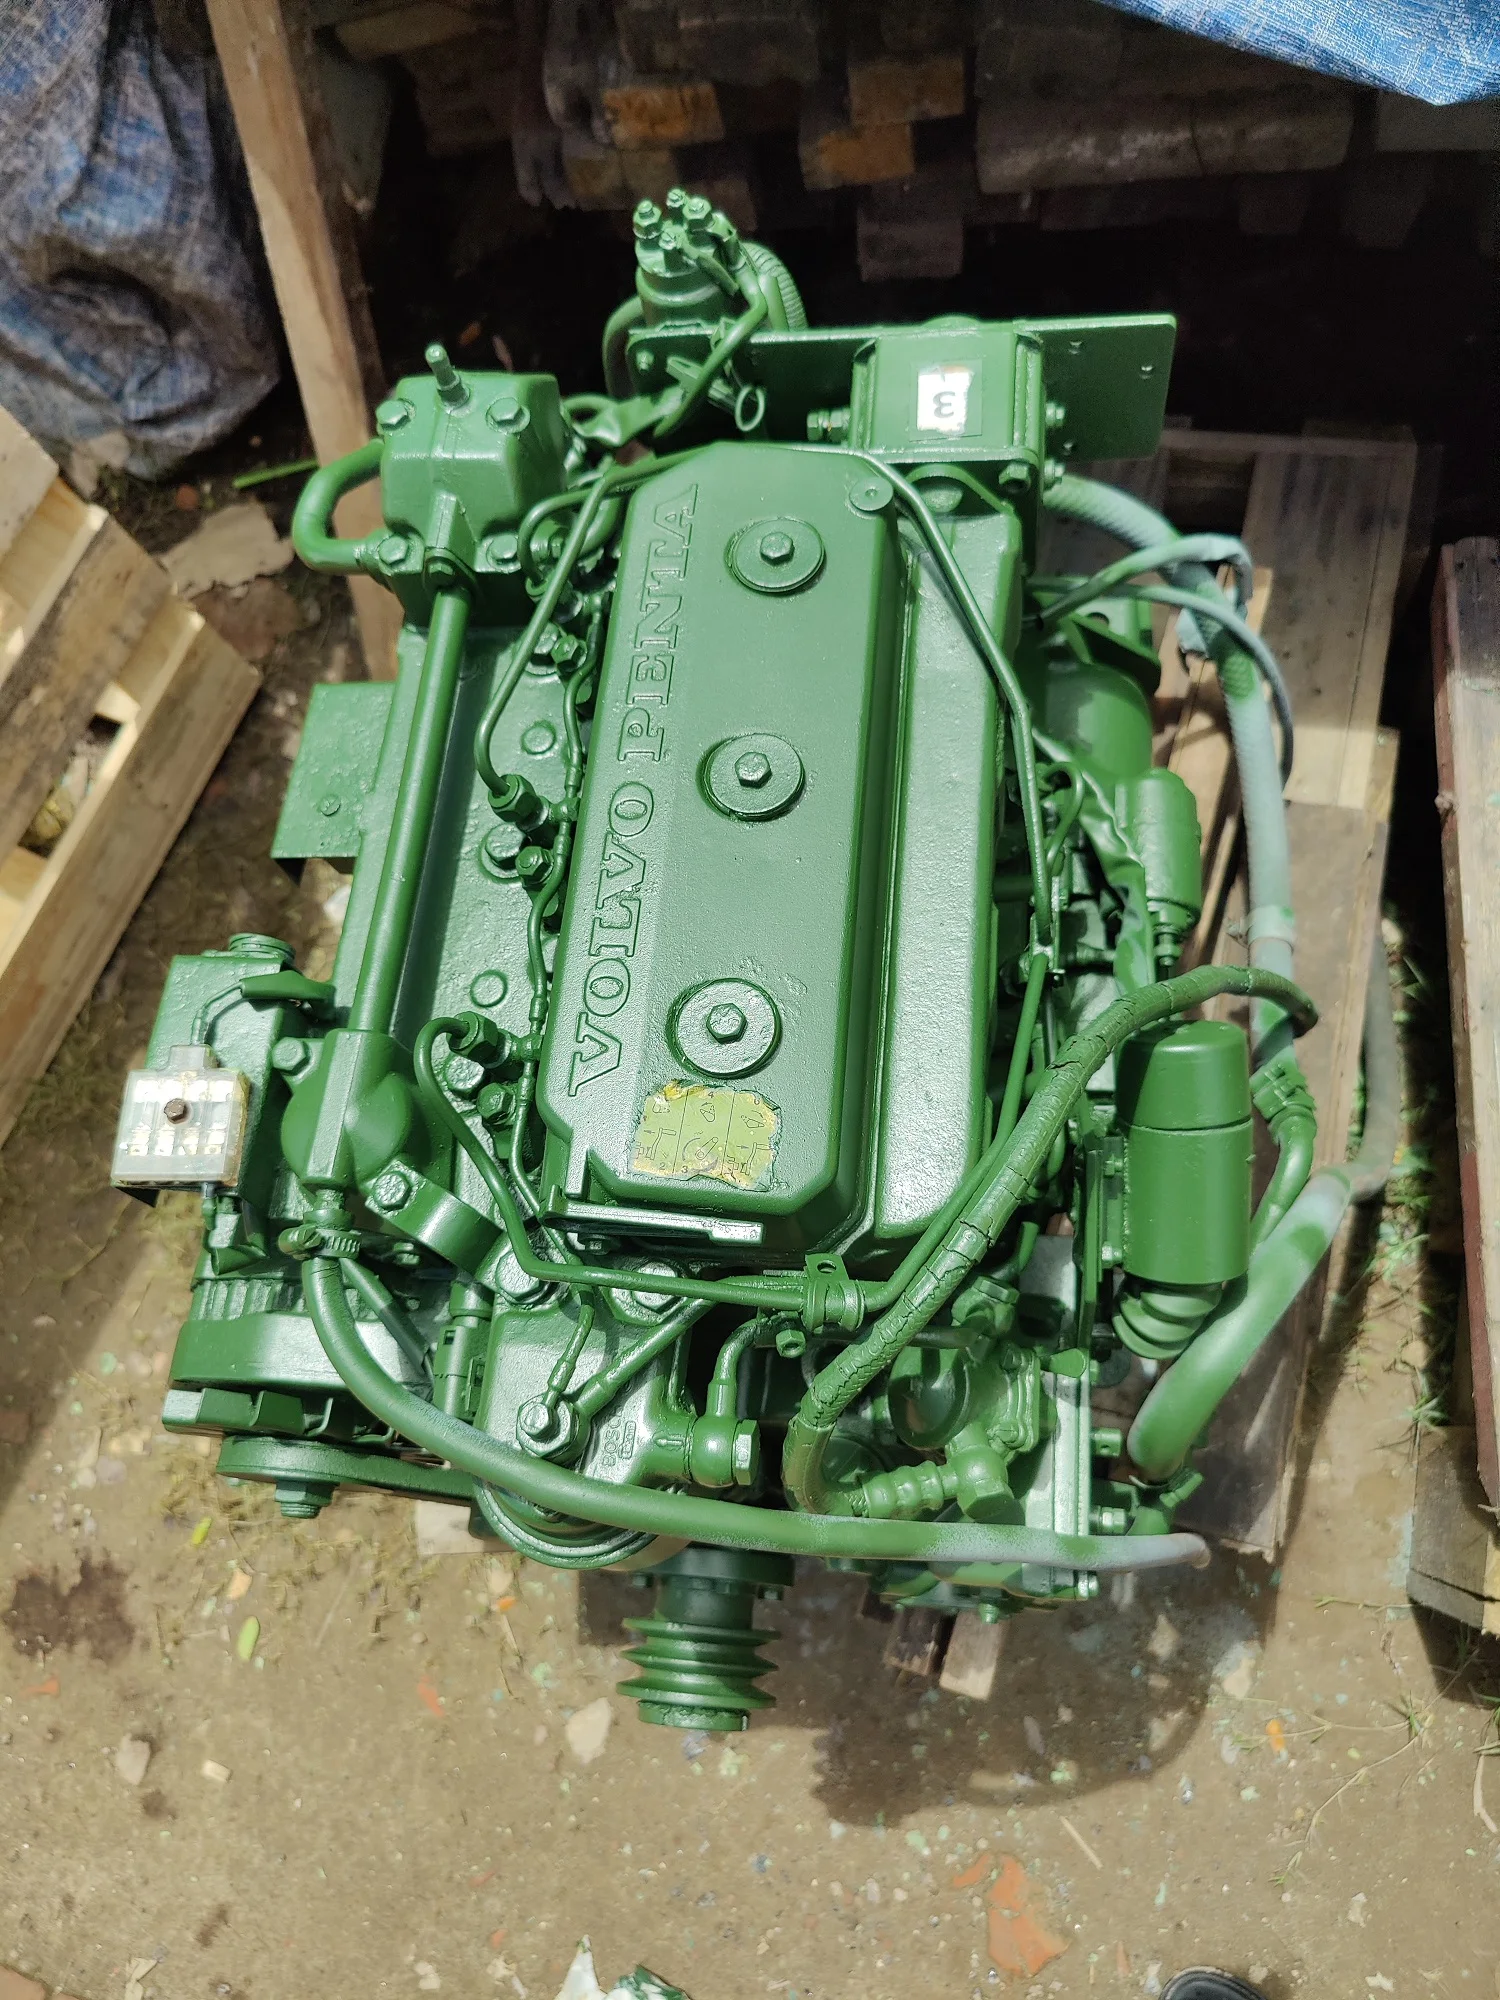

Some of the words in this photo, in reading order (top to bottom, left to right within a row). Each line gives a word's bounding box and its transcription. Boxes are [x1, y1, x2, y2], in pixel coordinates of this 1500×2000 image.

[932, 390, 956, 419] 3
[567, 781, 655, 1097] VOLVO
[617, 483, 699, 763] PENTA
